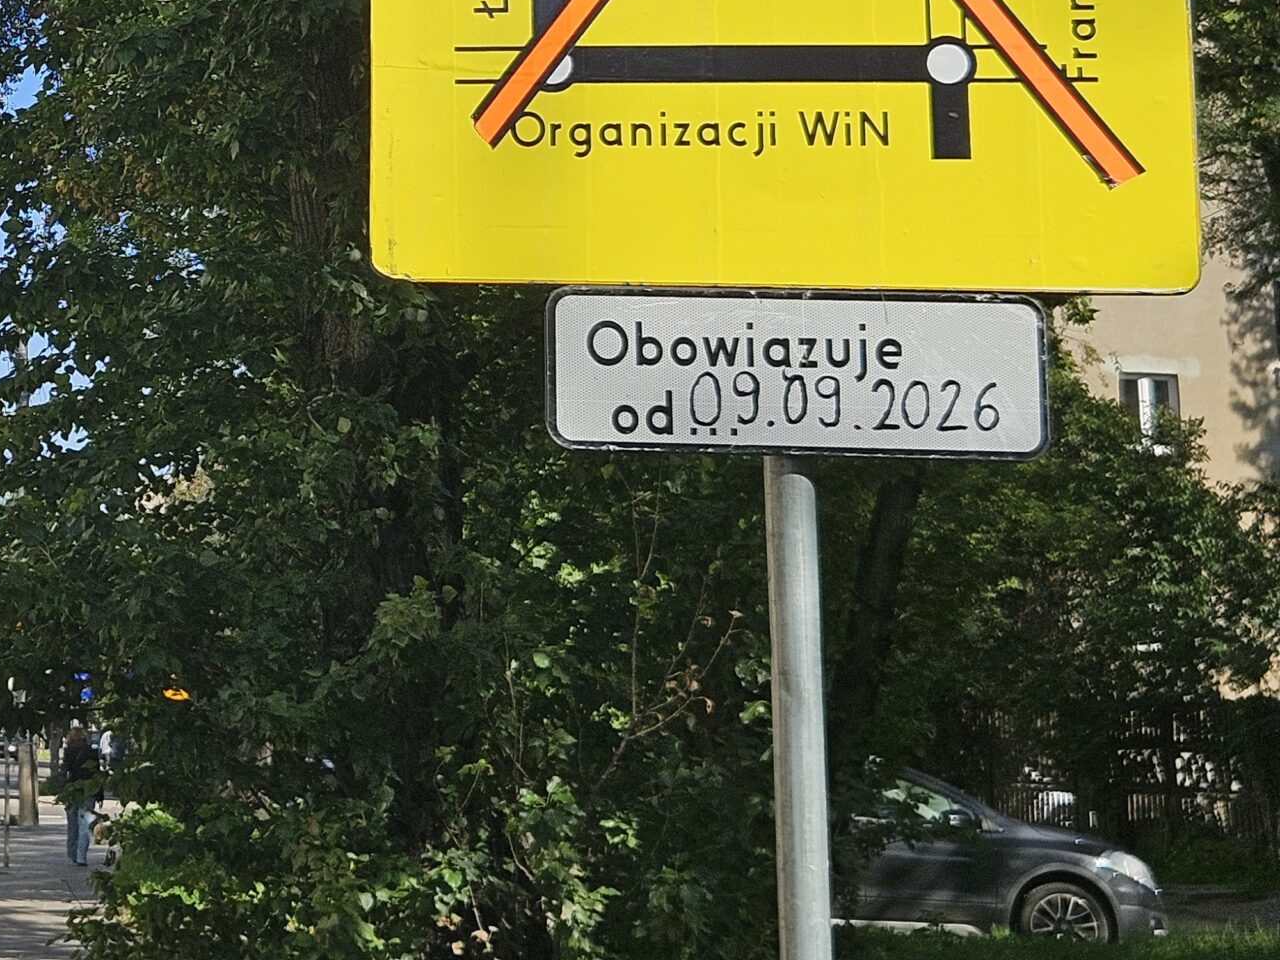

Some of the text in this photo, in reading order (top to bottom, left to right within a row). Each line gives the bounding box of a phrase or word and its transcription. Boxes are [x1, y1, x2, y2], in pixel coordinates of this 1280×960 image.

[510, 111, 890, 157] Organizacji WiN
[611, 389, 674, 436] od
